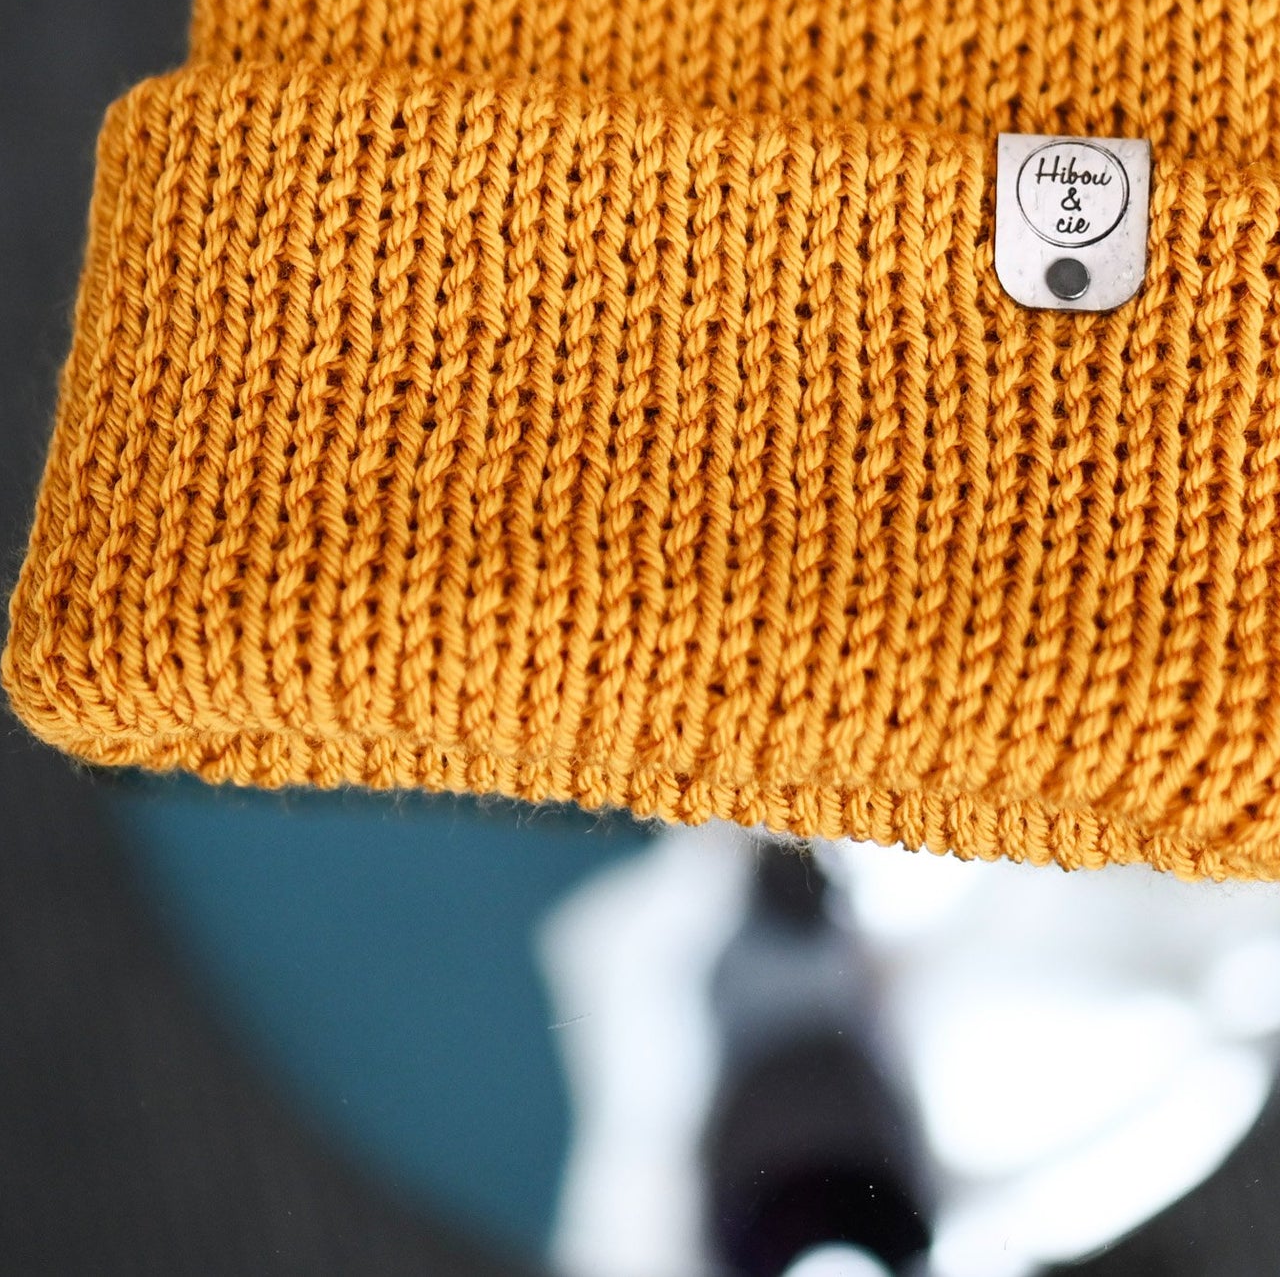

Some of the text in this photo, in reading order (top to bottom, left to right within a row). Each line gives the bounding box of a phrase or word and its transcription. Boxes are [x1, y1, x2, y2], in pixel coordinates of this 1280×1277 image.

[1035, 155, 1112, 186] Hibou
[1060, 187, 1082, 212] &
[1056, 216, 1090, 234] cie
